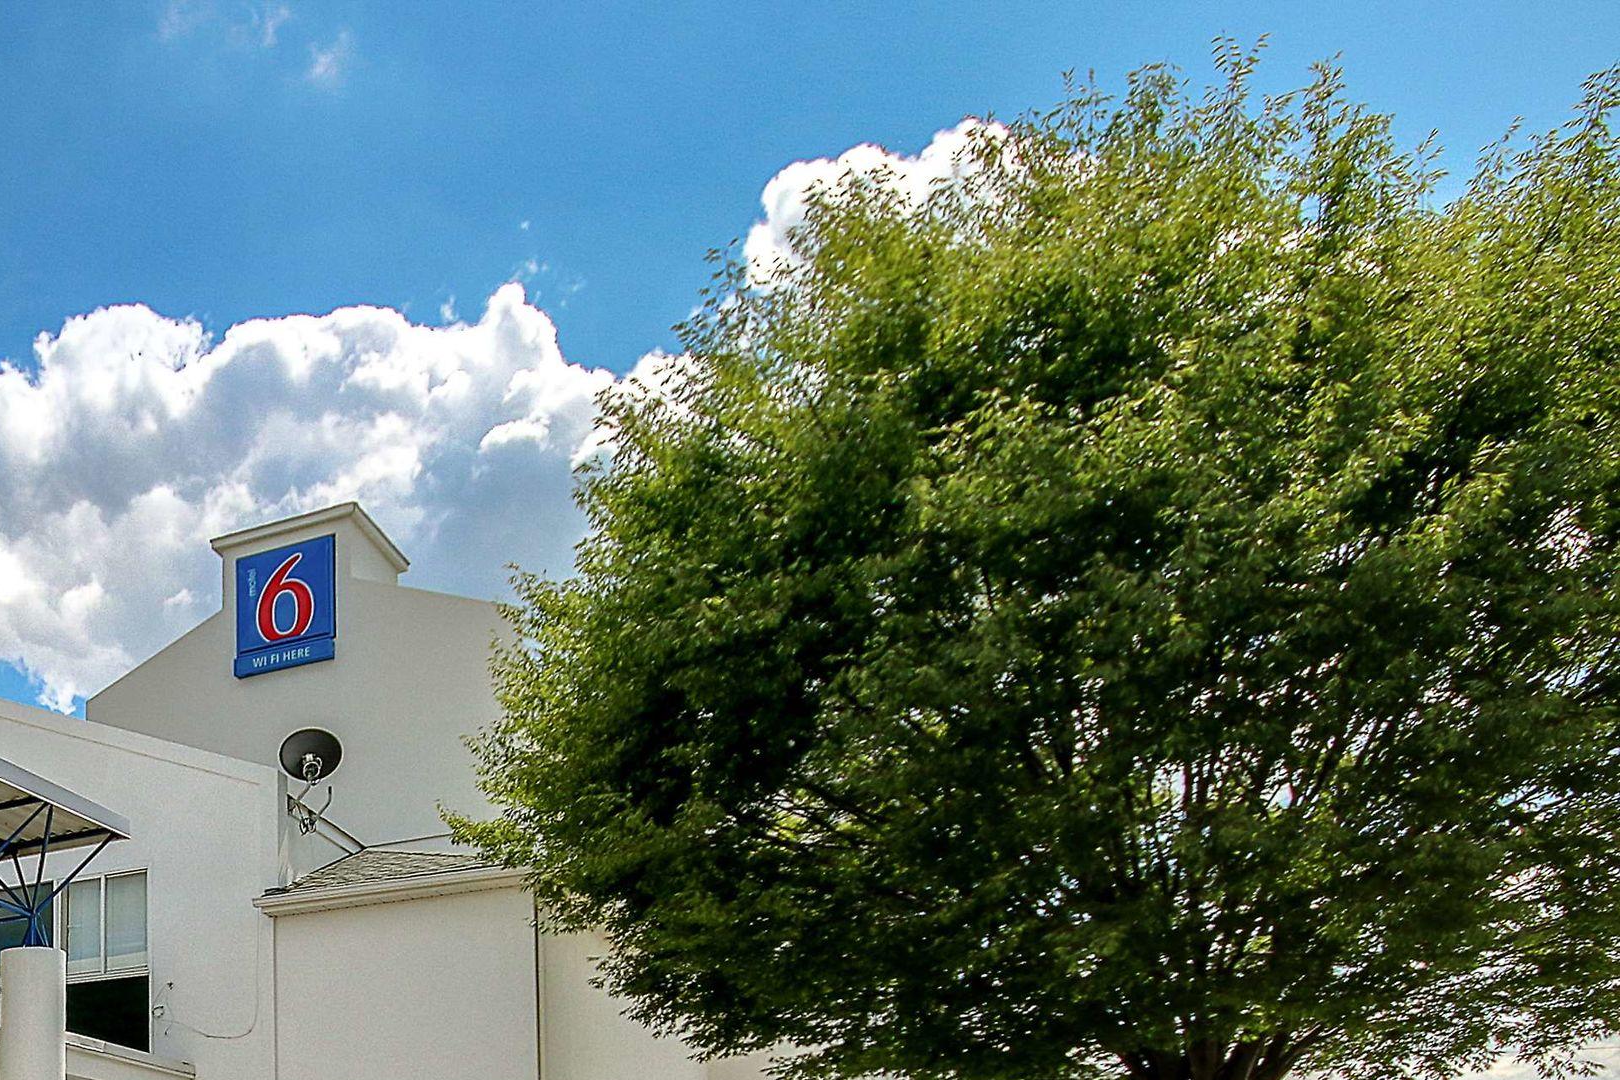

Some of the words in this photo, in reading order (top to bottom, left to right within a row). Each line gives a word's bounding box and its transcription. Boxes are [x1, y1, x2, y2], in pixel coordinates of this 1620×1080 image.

[256, 552, 315, 642] 6
[253, 656, 267, 667] WI
[270, 653, 279, 664] FI
[283, 646, 311, 661] HERE
